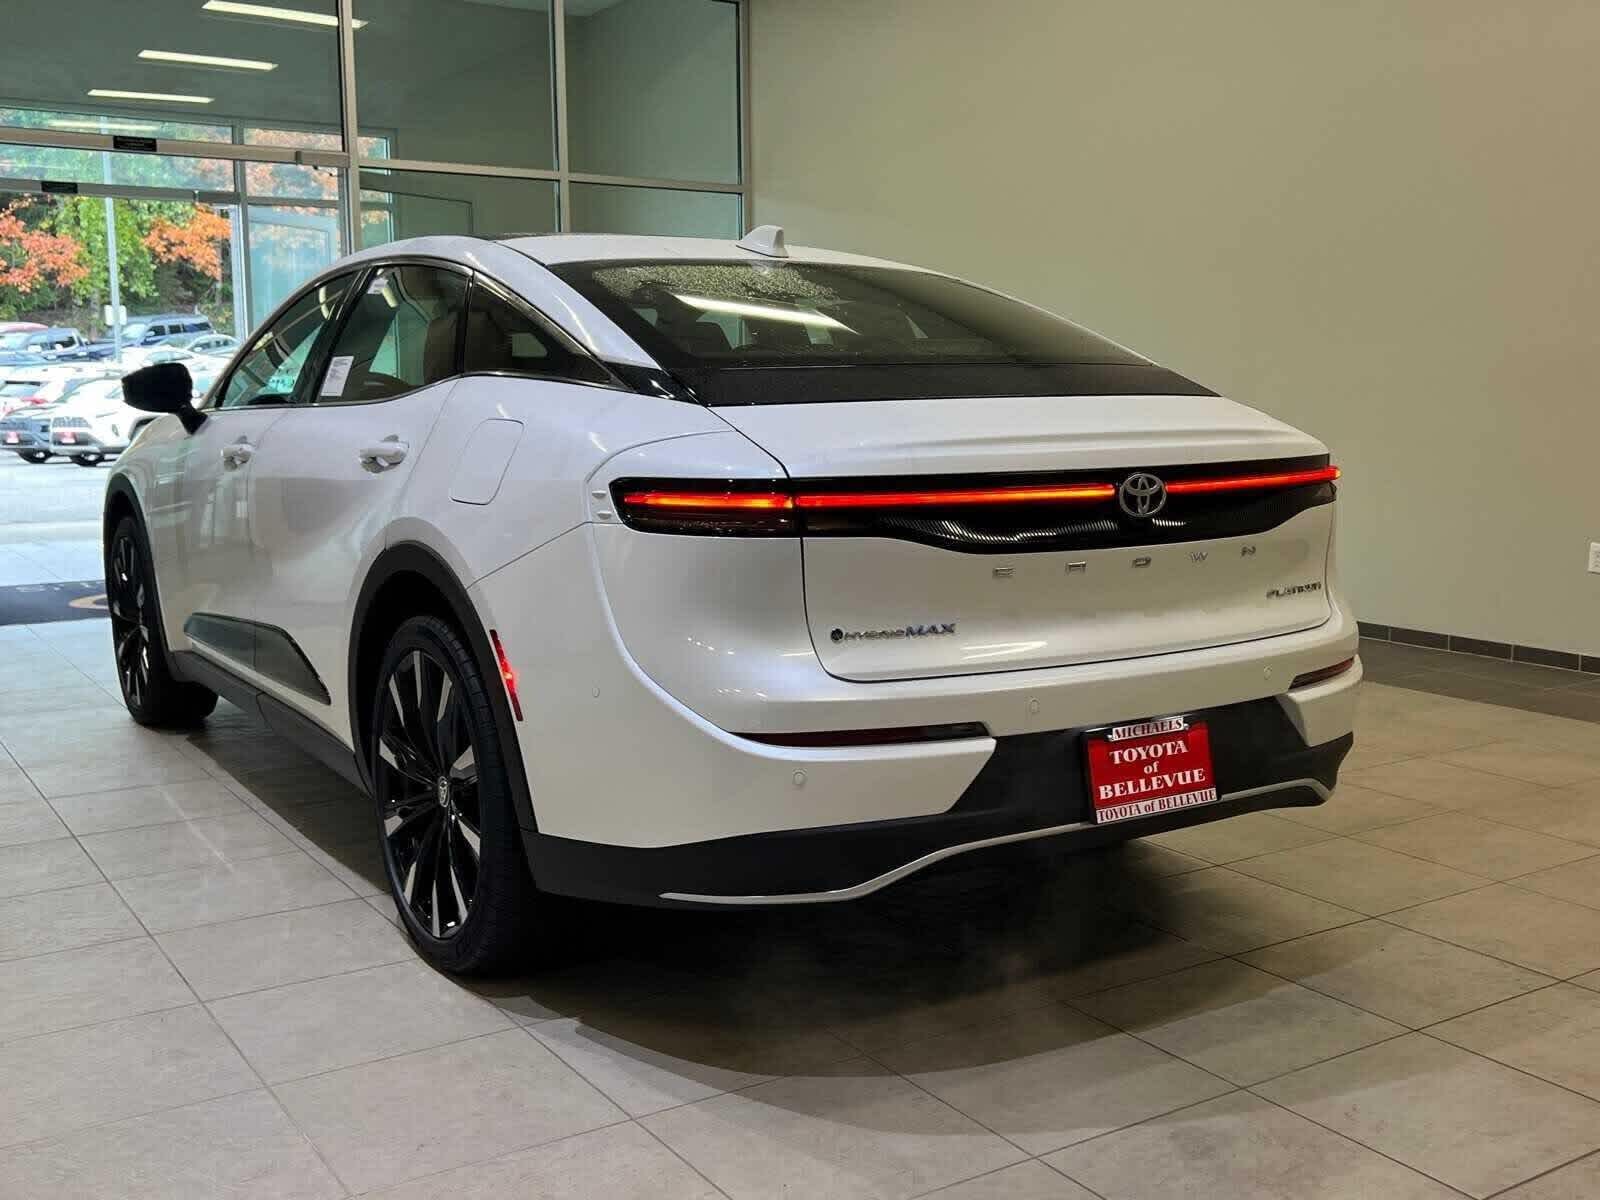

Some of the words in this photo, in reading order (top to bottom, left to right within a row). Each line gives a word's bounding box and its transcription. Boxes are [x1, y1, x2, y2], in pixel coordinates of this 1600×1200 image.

[1110, 741, 1188, 765] TOYOTA
[1143, 761, 1160, 775] of
[1099, 768, 1206, 800] BELLEVUE
[1099, 803, 1141, 822] TOYOTA
[1144, 801, 1156, 812] of
[1158, 789, 1216, 810] BELLEVUE
